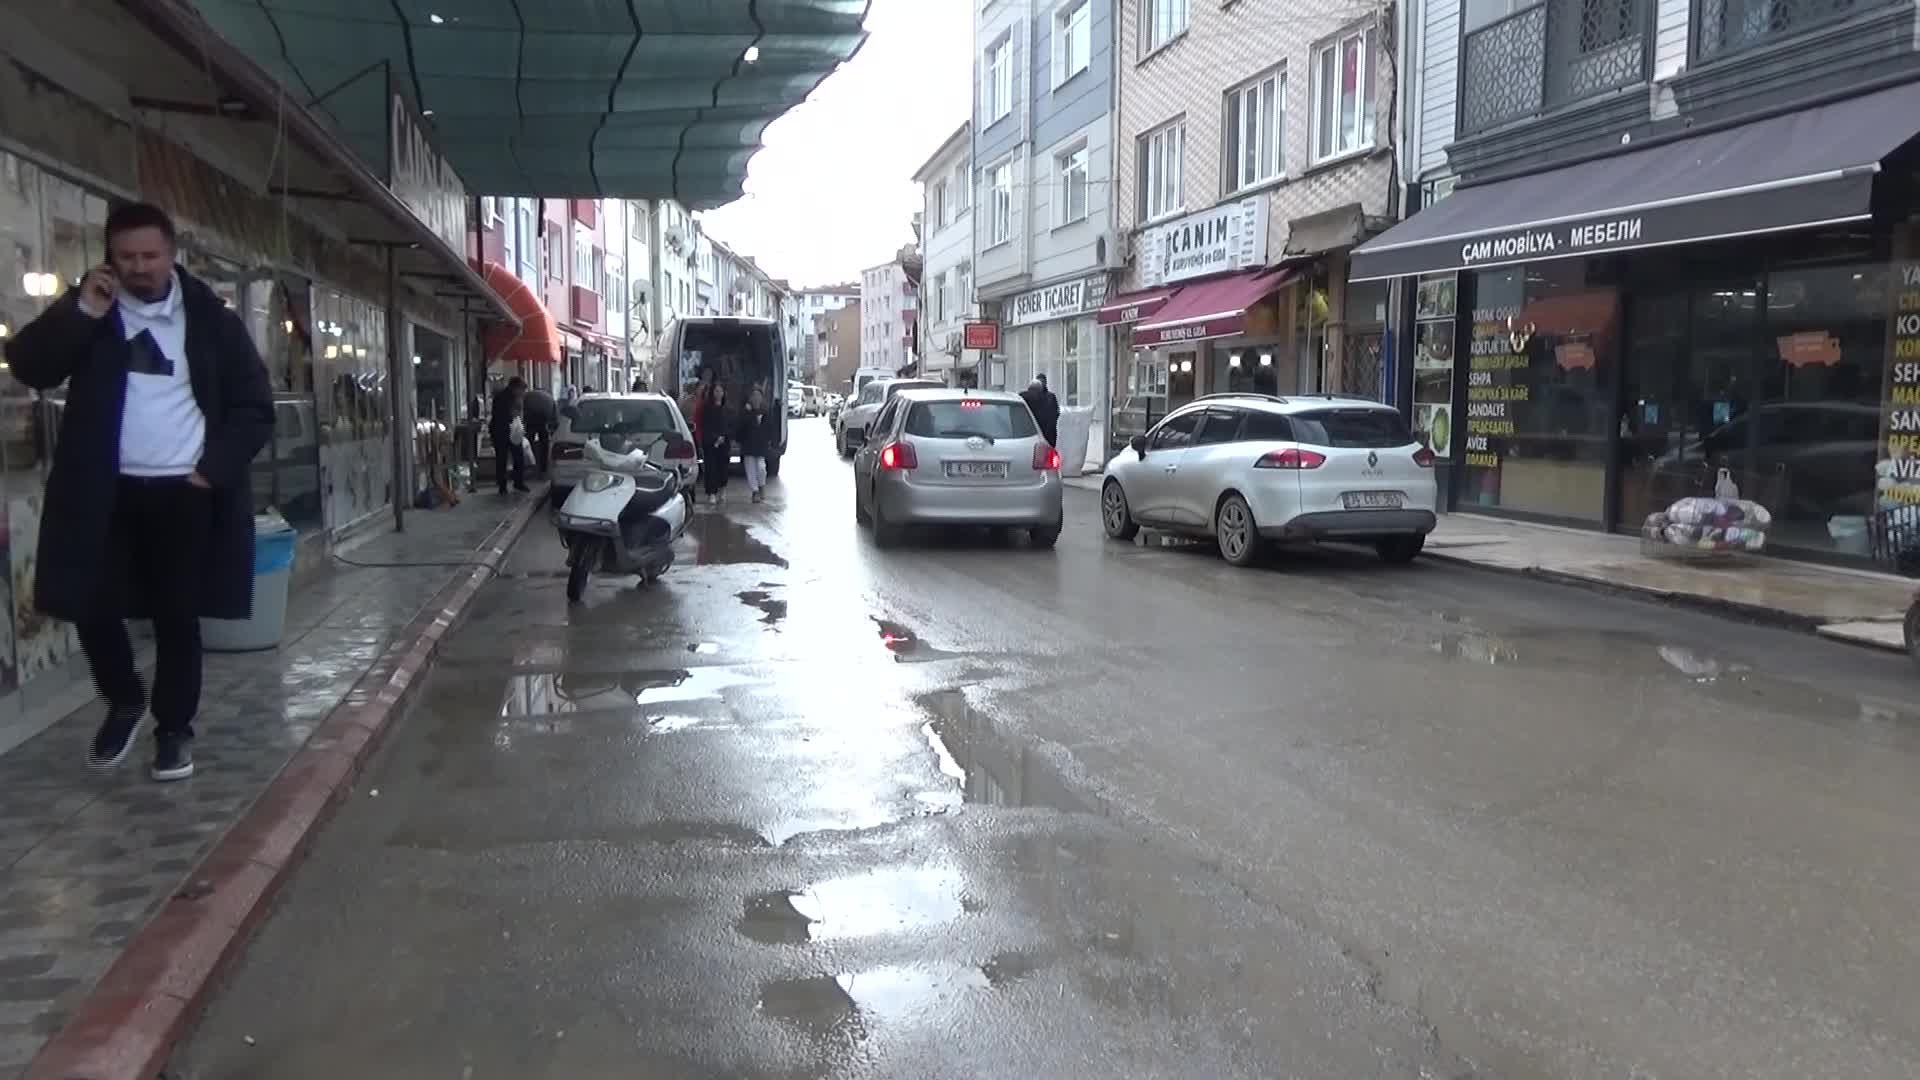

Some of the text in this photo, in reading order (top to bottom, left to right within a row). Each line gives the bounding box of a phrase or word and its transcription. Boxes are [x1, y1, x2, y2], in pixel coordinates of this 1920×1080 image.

[1172, 215, 1228, 253] CANIM
[1462, 241, 1491, 265] ÇAM
[1494, 230, 1555, 257] MOBİLYA
[1571, 218, 1642, 247] МЕБЕЛИ
[1045, 284, 1081, 310] TİCARET
[1468, 372, 1492, 386] SEHPA
[1467, 403, 1505, 417] SANDALYE
[1466, 434, 1488, 451] AVİZE
